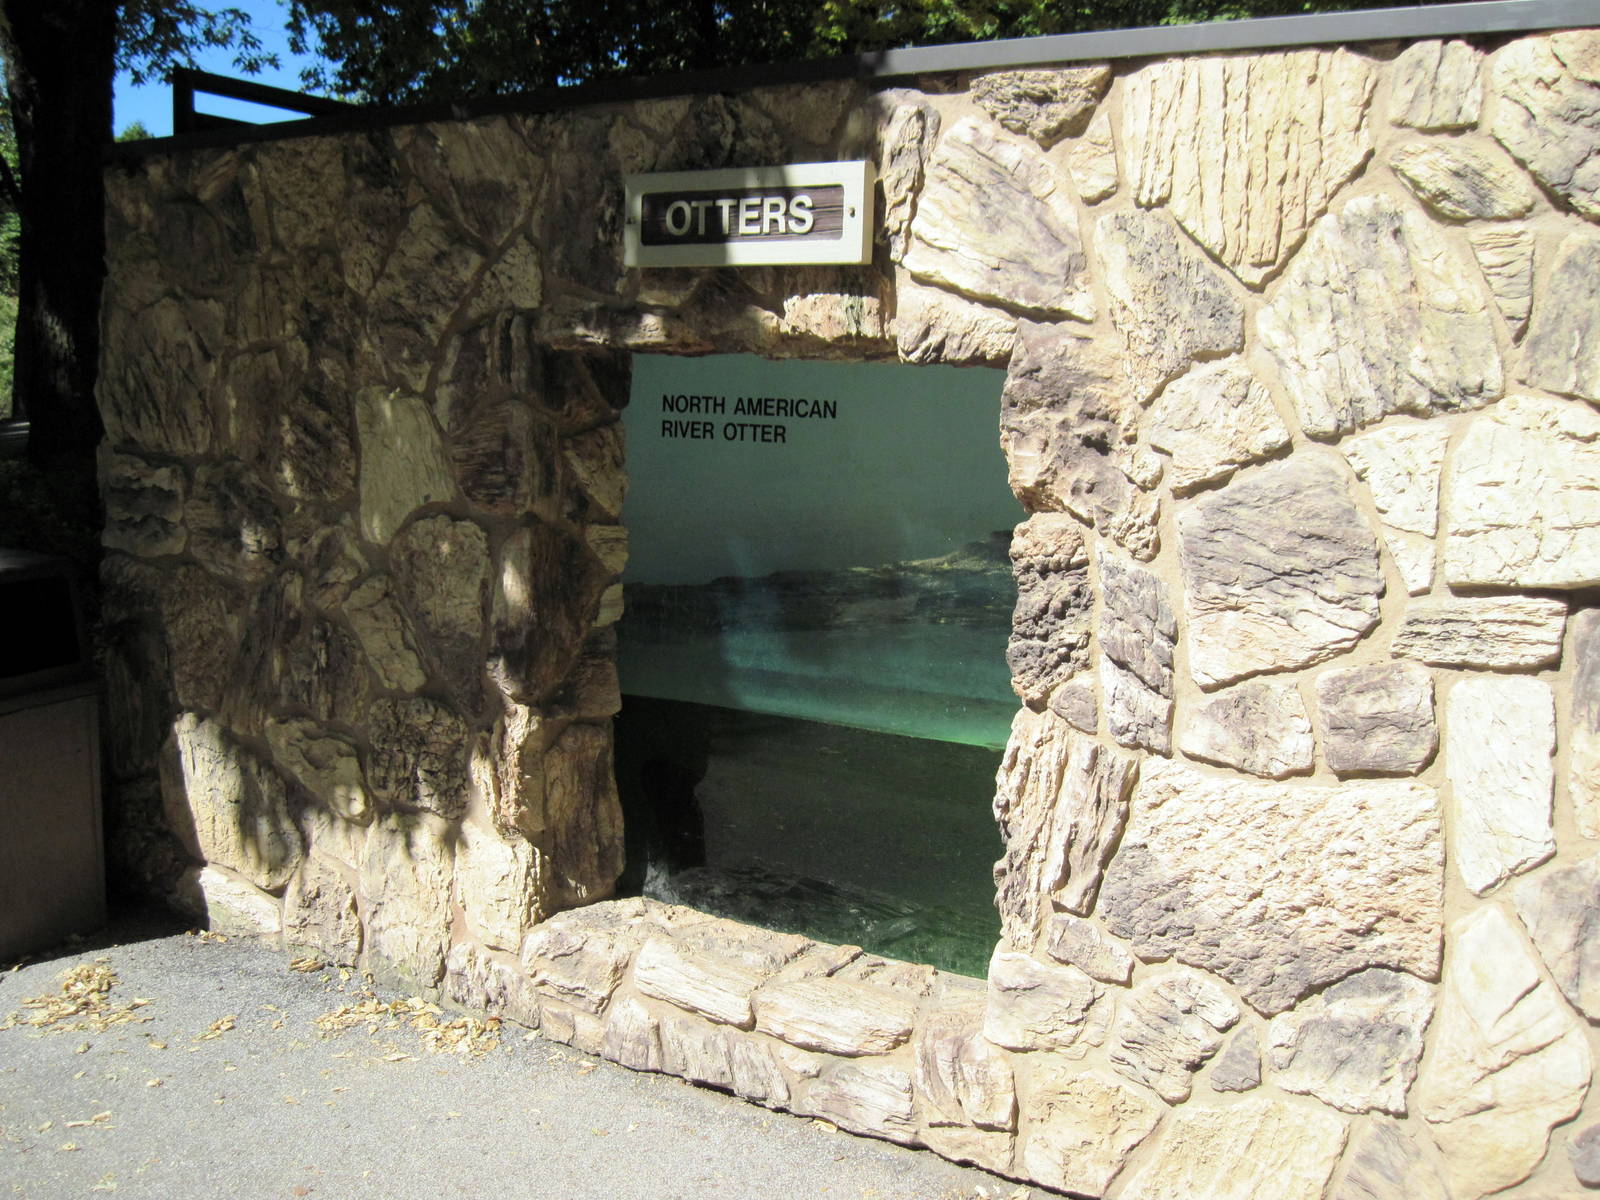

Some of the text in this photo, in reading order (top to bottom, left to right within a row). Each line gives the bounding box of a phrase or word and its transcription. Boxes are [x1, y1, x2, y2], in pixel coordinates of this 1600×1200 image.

[665, 194, 815, 236] OTTERS
[662, 394, 837, 419] NORTH AMERICAN
[661, 420, 787, 443] RIVER OTTER
